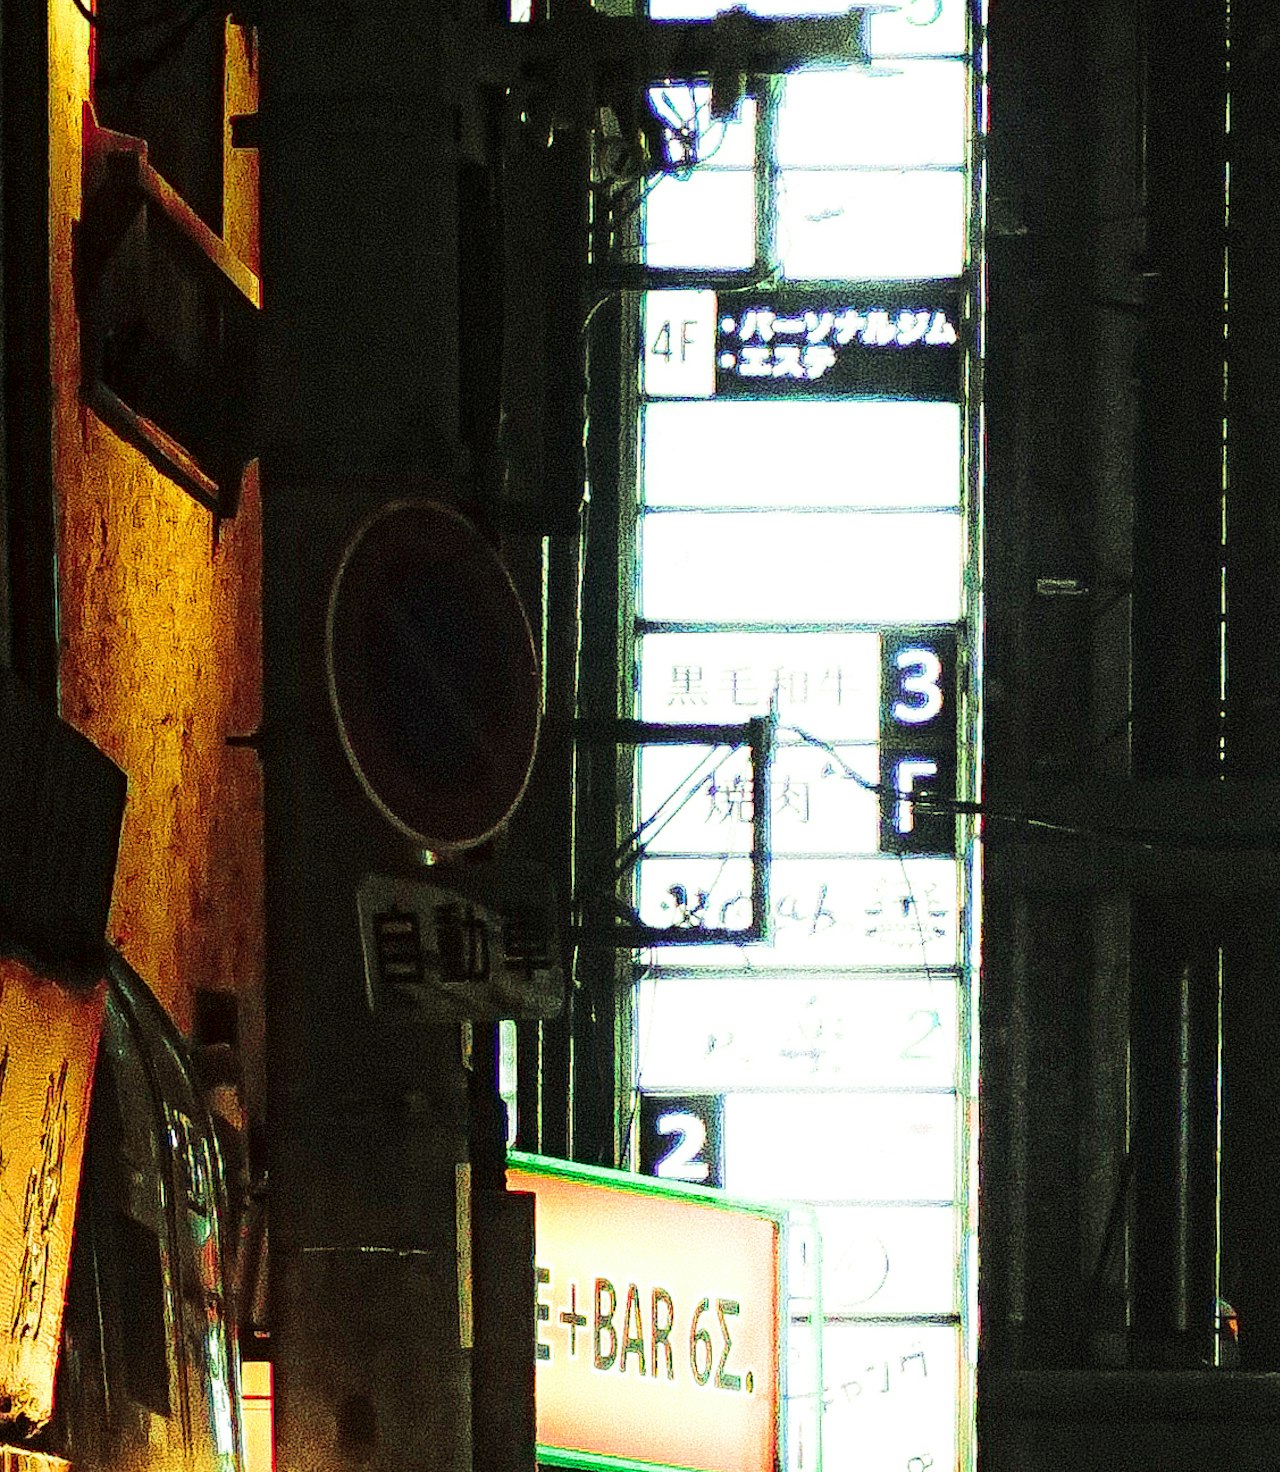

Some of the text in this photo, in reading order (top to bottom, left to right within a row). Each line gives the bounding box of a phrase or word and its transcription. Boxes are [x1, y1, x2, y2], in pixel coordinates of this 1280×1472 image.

[650, 319, 699, 365] 4F
[737, 347, 838, 380] エステ
